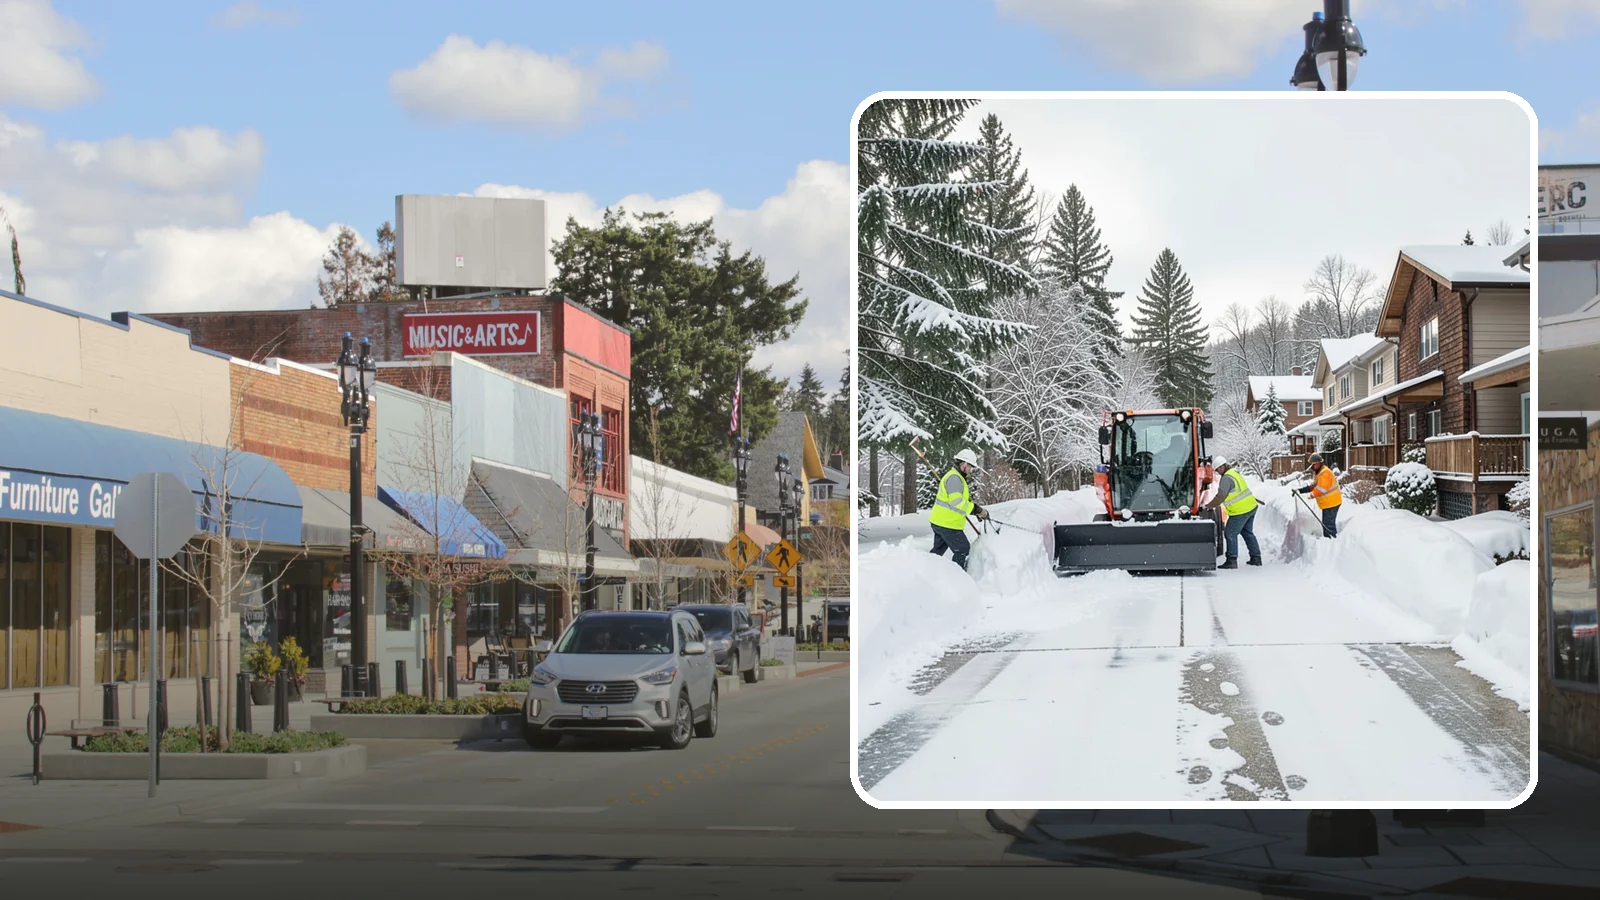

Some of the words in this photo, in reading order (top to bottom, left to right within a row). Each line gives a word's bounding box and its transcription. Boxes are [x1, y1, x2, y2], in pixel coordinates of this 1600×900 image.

[409, 323, 519, 349] MUSIC&ARTS
[0, 471, 79, 515] Furniture
[89, 482, 122, 519] Gal
